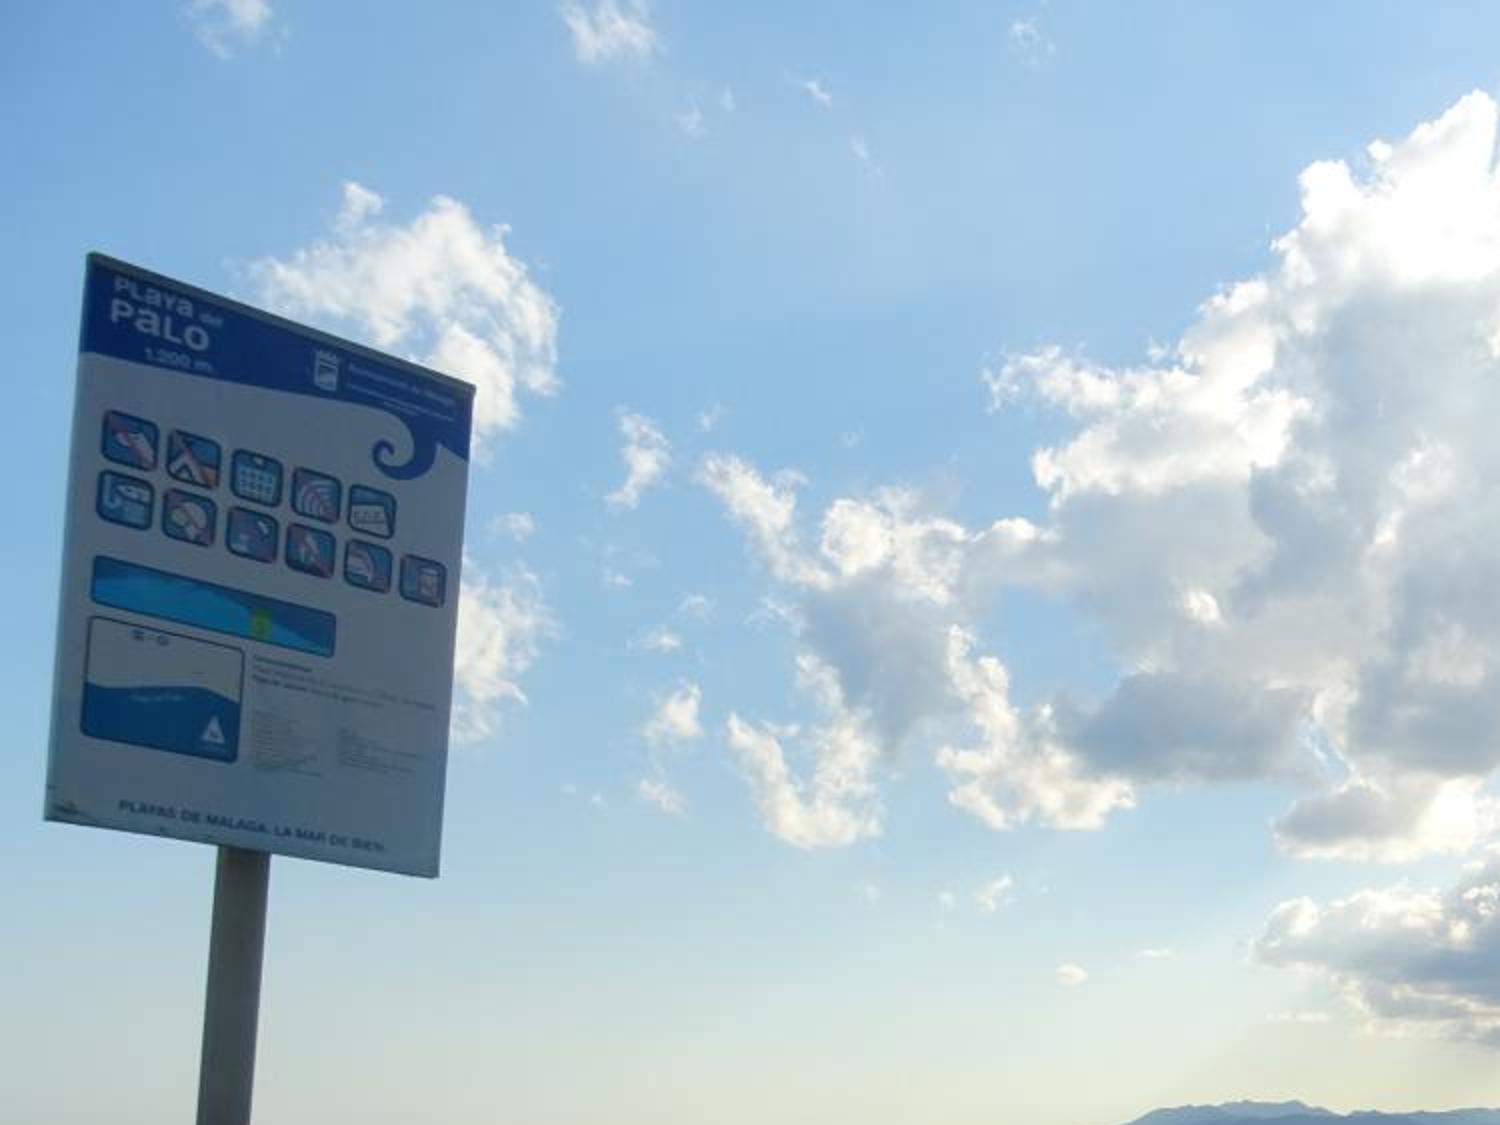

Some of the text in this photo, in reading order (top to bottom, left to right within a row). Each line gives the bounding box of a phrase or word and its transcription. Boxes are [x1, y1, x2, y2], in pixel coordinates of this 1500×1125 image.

[118, 799, 177, 820] PLAYAS
[180, 809, 202, 825] DE
[273, 824, 293, 838] LA
[294, 827, 325, 843] MAR
[328, 833, 349, 848] DE
